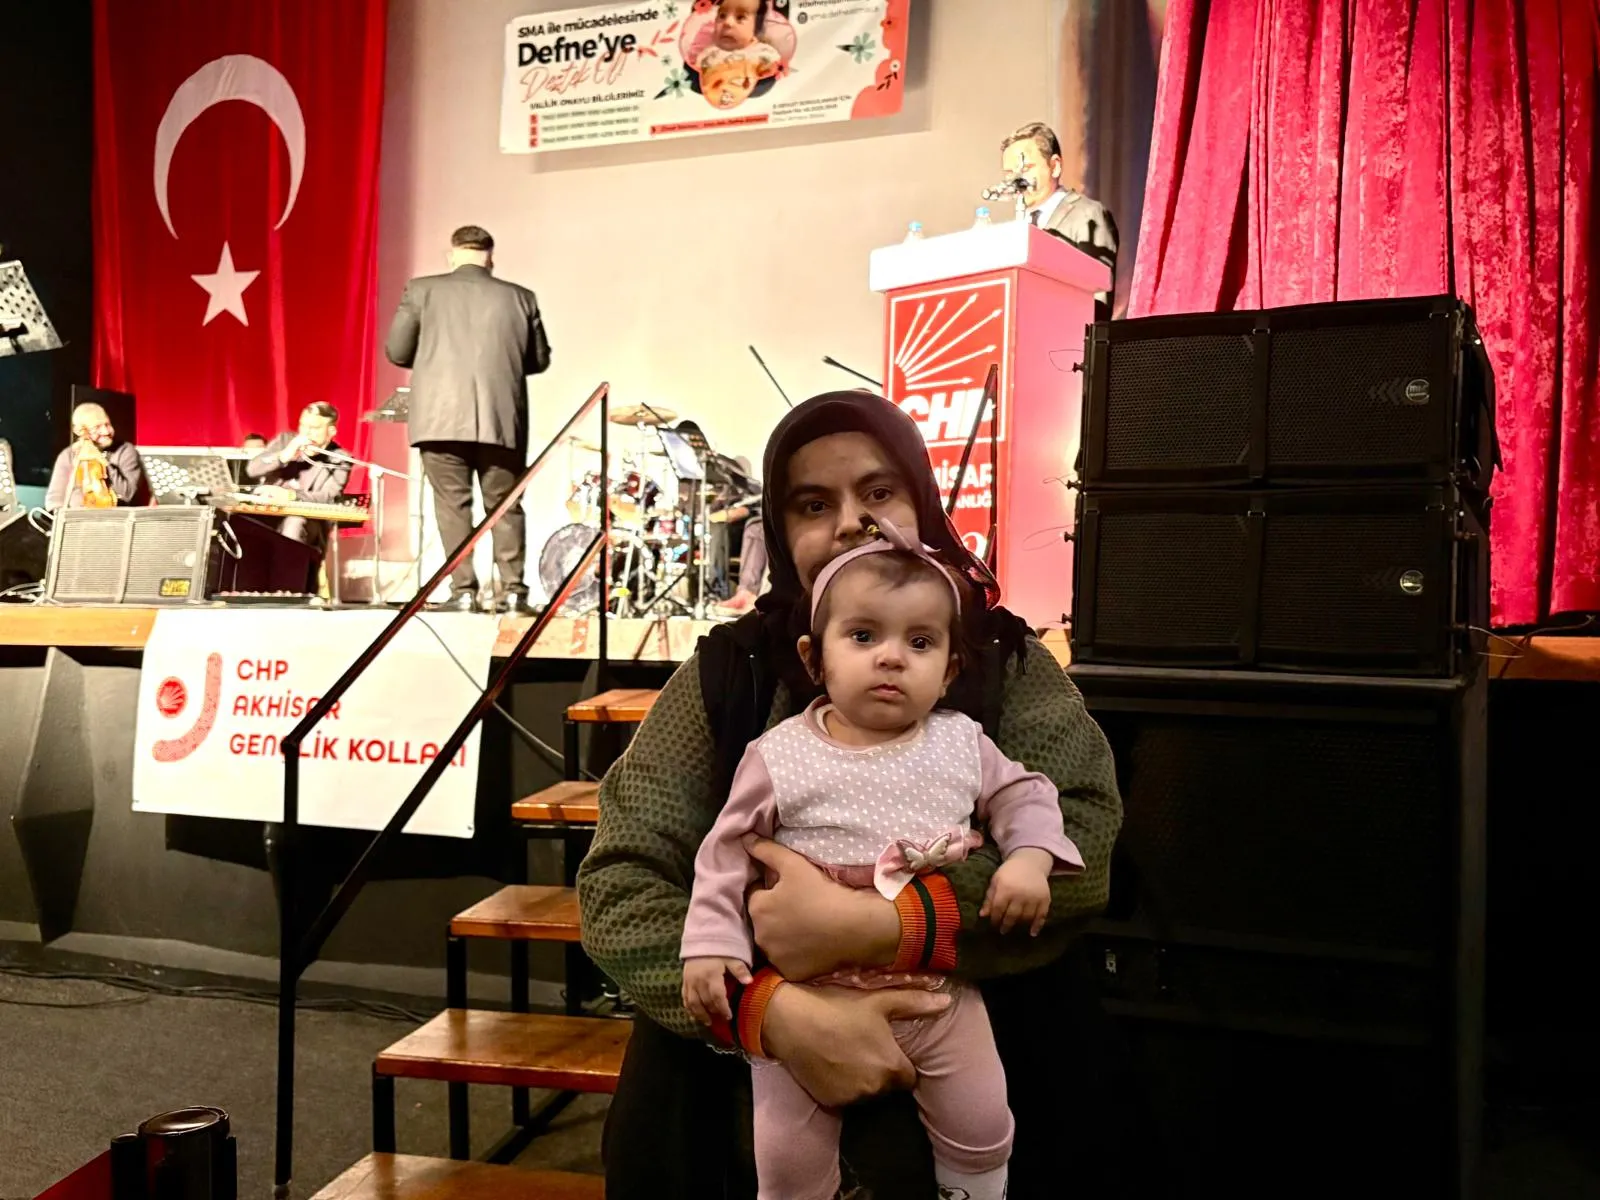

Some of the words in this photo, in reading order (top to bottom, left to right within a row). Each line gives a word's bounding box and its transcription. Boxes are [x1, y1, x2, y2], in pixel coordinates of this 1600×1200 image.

[518, 25, 545, 38] SMA
[547, 22, 562, 34] ile
[563, 9, 659, 31] mücadelesinde
[517, 33, 637, 67] Defne'ye
[898, 387, 996, 440] CHP
[237, 659, 289, 681] CHP
[229, 730, 339, 762] GENLİK
[348, 738, 466, 767] KOLLAI
